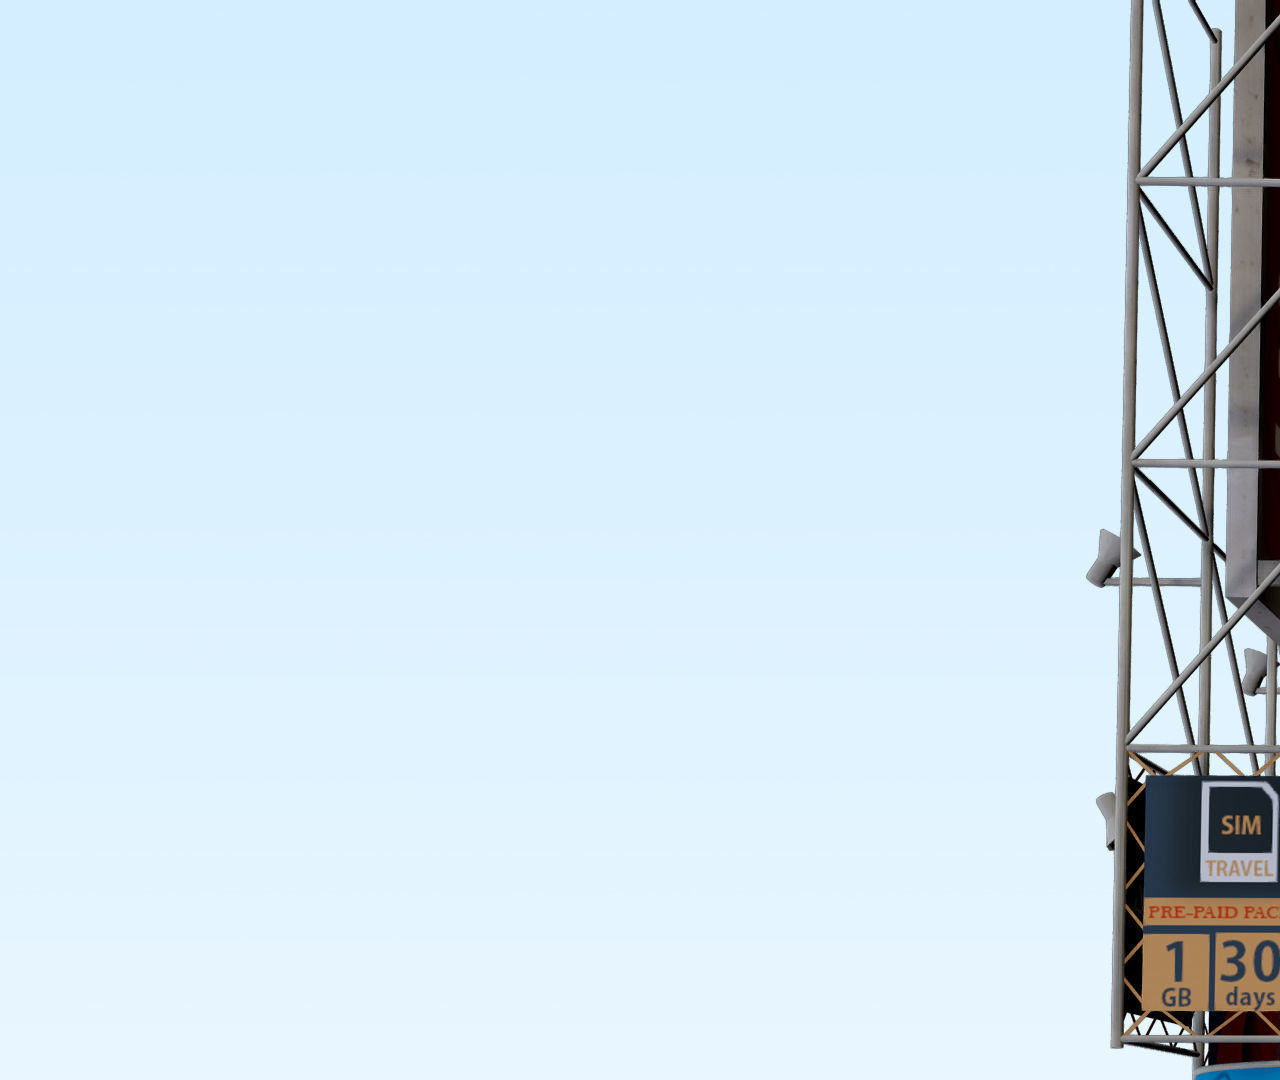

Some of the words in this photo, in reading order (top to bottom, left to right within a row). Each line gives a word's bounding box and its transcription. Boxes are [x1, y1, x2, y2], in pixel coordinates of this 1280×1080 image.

[1222, 815, 1261, 835] SIM
[1205, 860, 1273, 877] TRAVEL
[1149, 906, 1238, 919] PRE-PAID
[1166, 941, 1183, 982] 1
[1220, 940, 1280, 982] 30
[1162, 988, 1191, 1007] GB
[1226, 986, 1275, 1010] days
